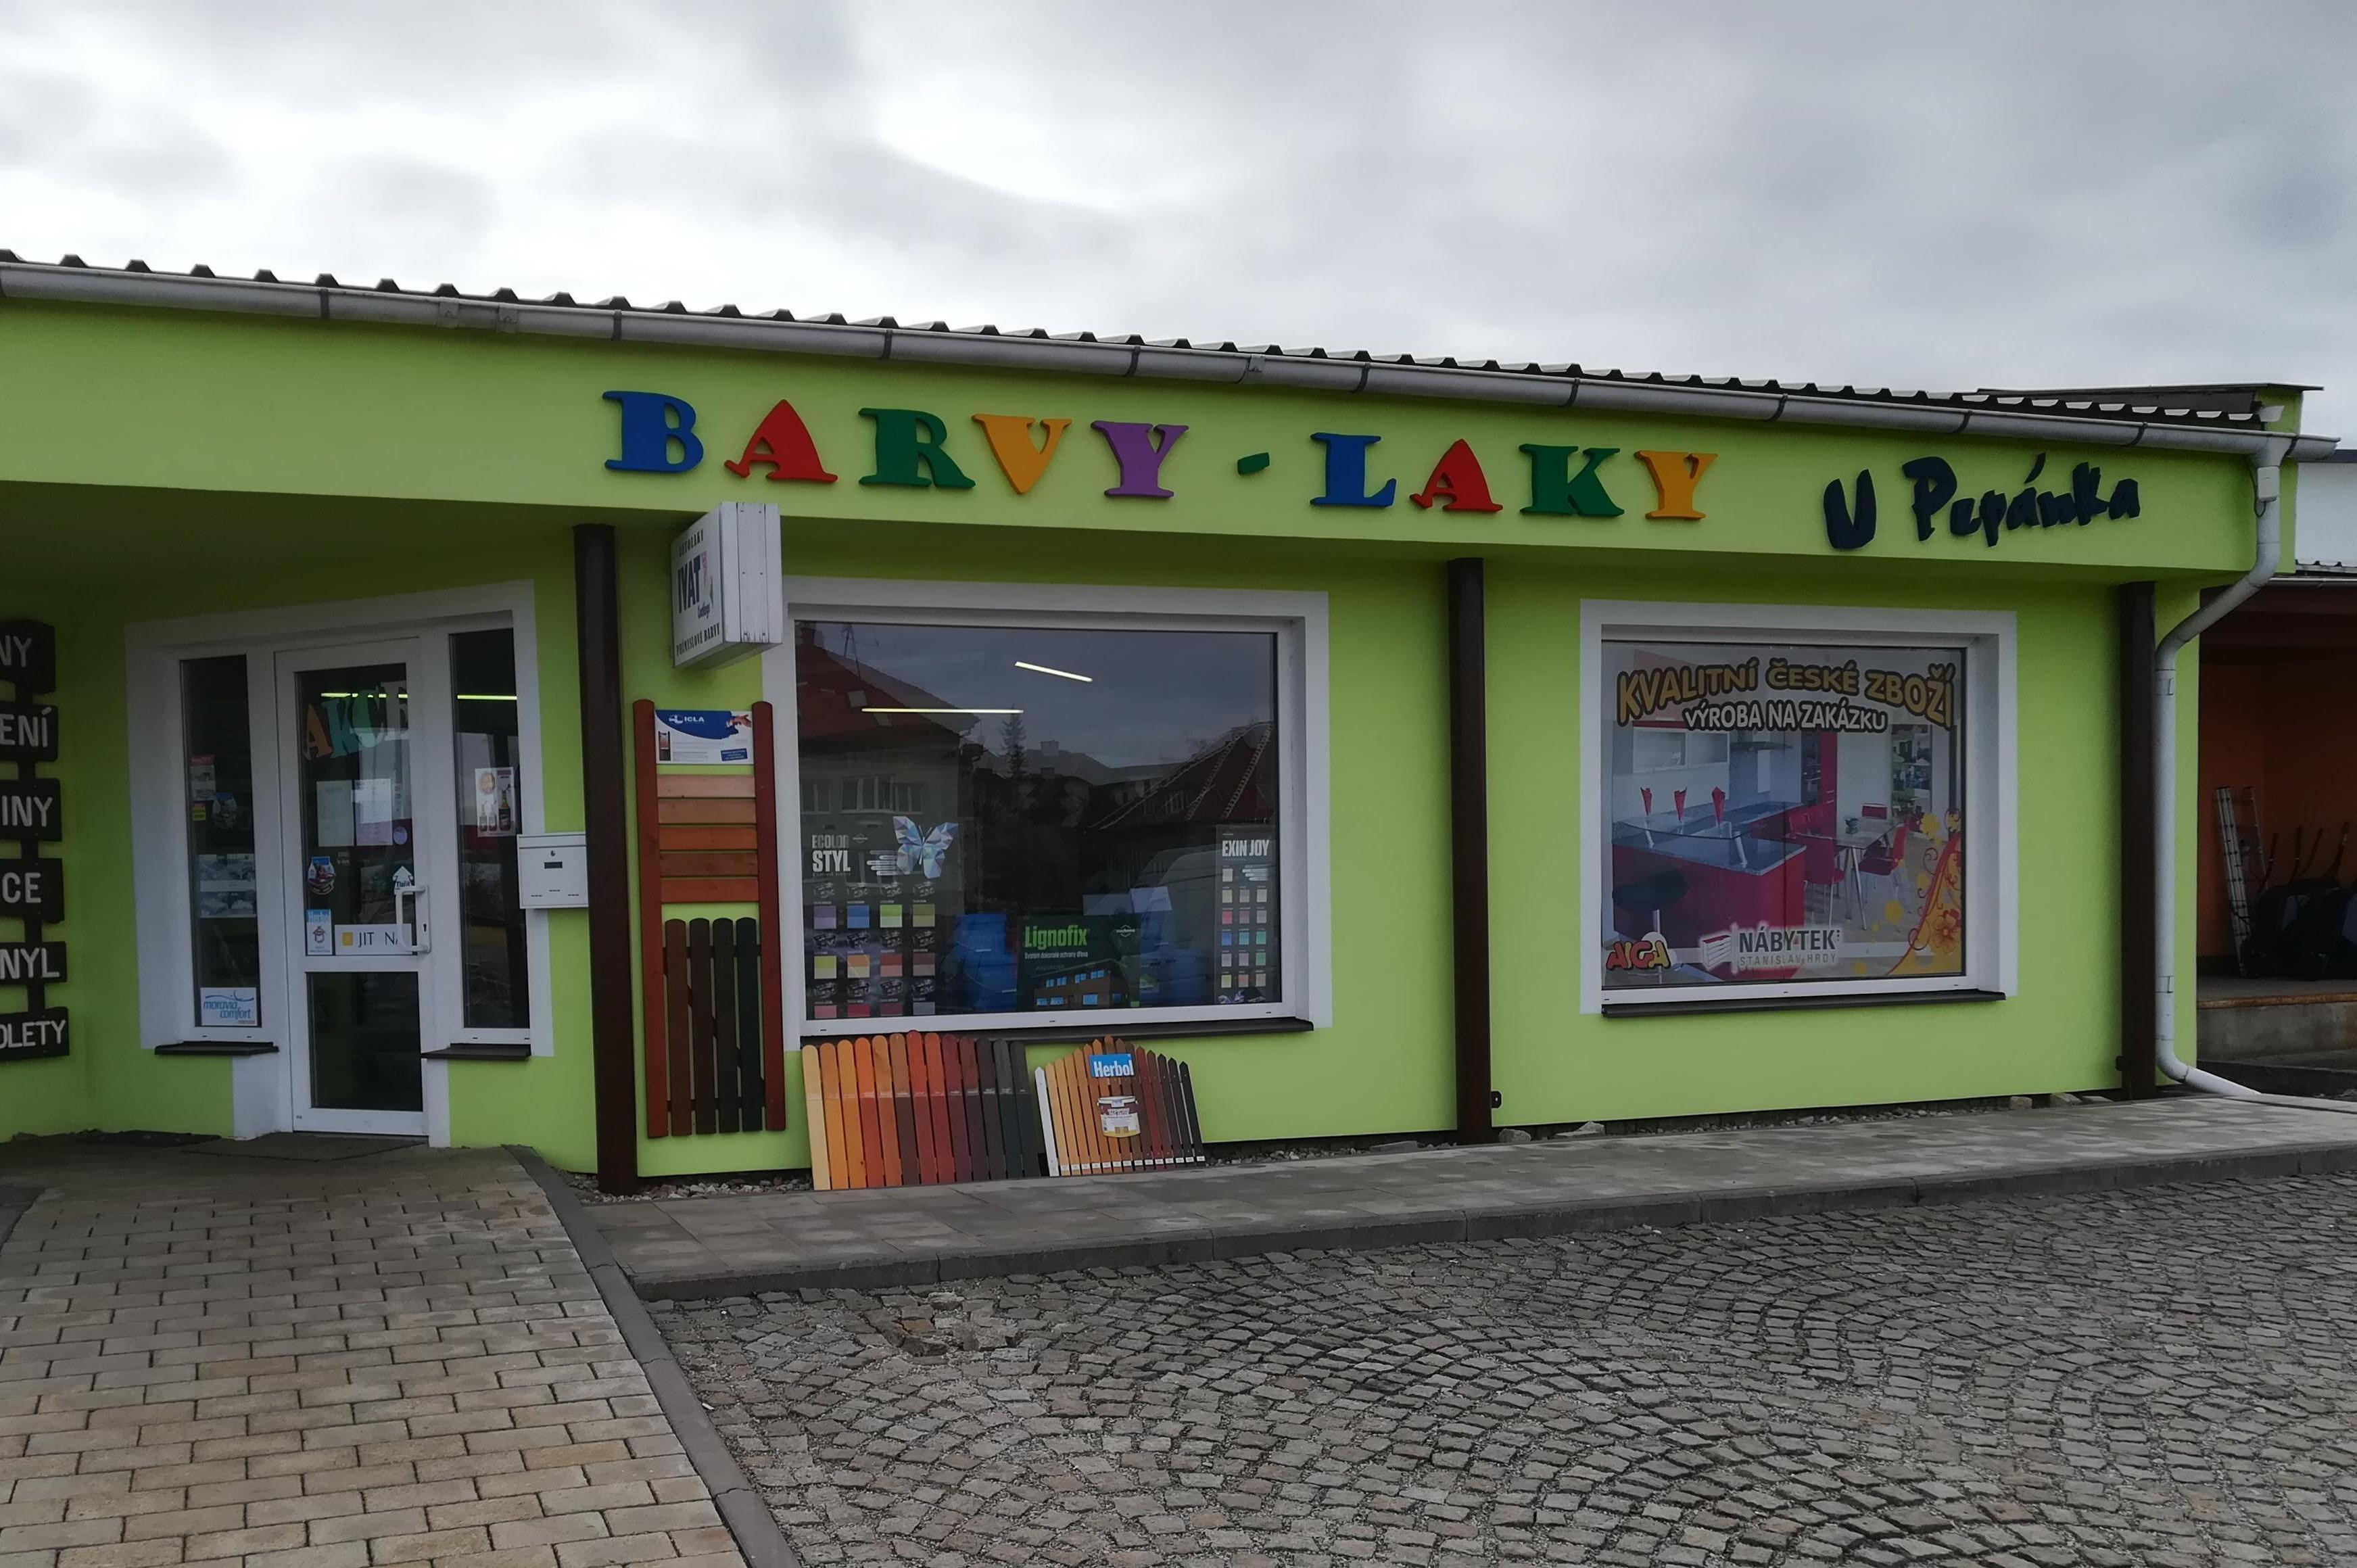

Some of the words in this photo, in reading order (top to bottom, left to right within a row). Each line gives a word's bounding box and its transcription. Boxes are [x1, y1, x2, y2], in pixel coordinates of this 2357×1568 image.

[602, 390, 1189, 498] BARVY
[1310, 432, 1718, 520] LAKY
[1824, 469, 1877, 549] U
[1901, 452, 2141, 547] Pepánka
[1619, 658, 1759, 726] KVALITNÍ
[1767, 658, 1859, 694] ČESKÉ
[1865, 663, 1954, 728] ZBOŽÍ
[1684, 701, 1762, 730] VÝROBA
[1768, 701, 1793, 730] NA
[1799, 698, 1886, 730] ZAKÁZKU
[813, 850, 851, 872] STYL
[1222, 840, 1247, 857] EXIN
[1249, 839, 1270, 857] JOY
[1024, 924, 1087, 950] Lignofix
[1093, 1060, 1135, 1078] Herbol
